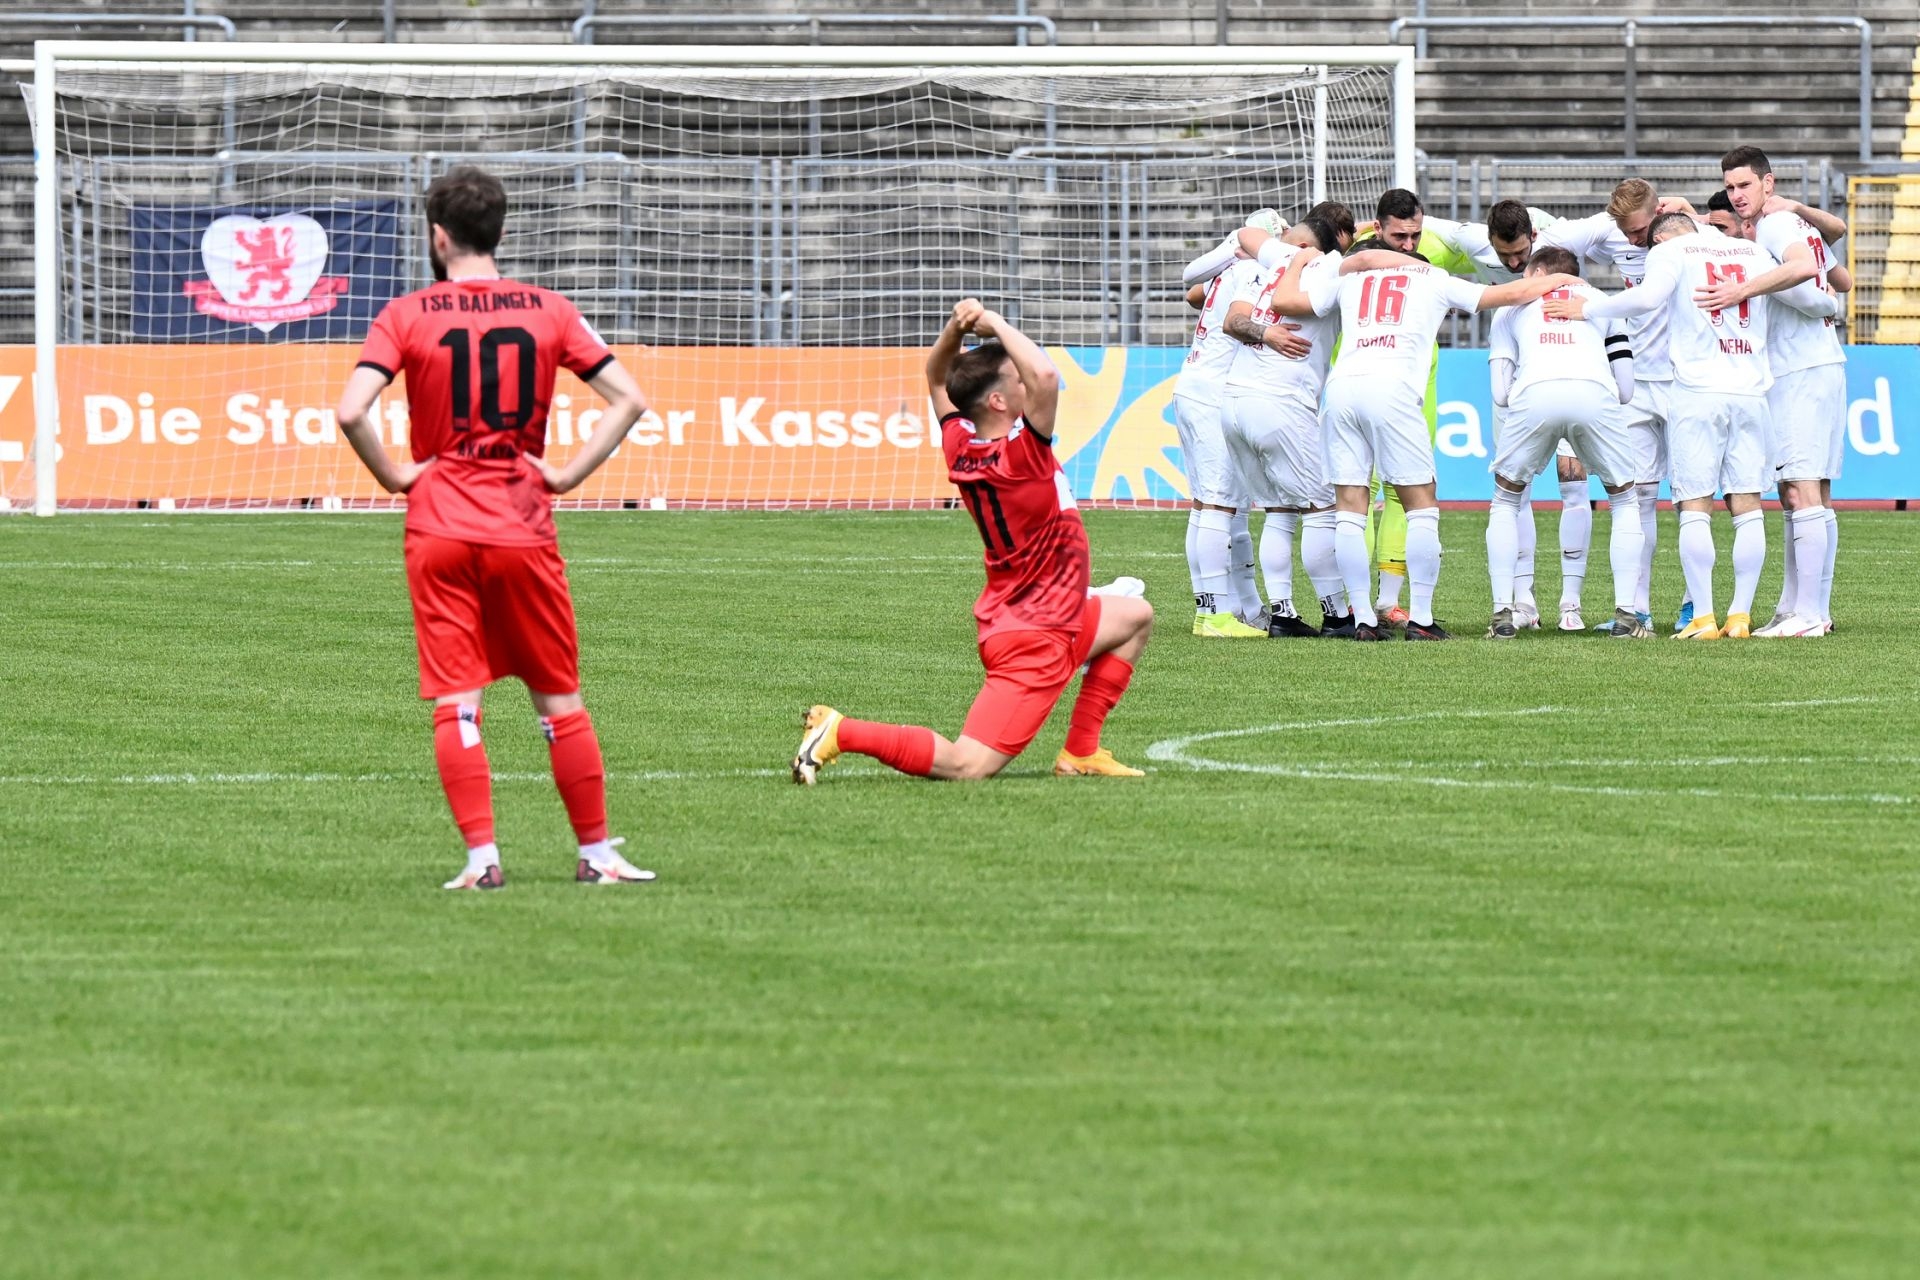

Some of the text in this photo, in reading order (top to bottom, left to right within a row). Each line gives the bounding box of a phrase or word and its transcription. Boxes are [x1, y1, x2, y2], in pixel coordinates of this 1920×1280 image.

[421, 291, 543, 313] TSG BALINGEN
[1358, 274, 1410, 327] 16
[1539, 332, 1576, 345] BRILL
[1718, 338, 1753, 354] MEHA
[438, 326, 537, 432] 10
[83, 391, 202, 445] Die
